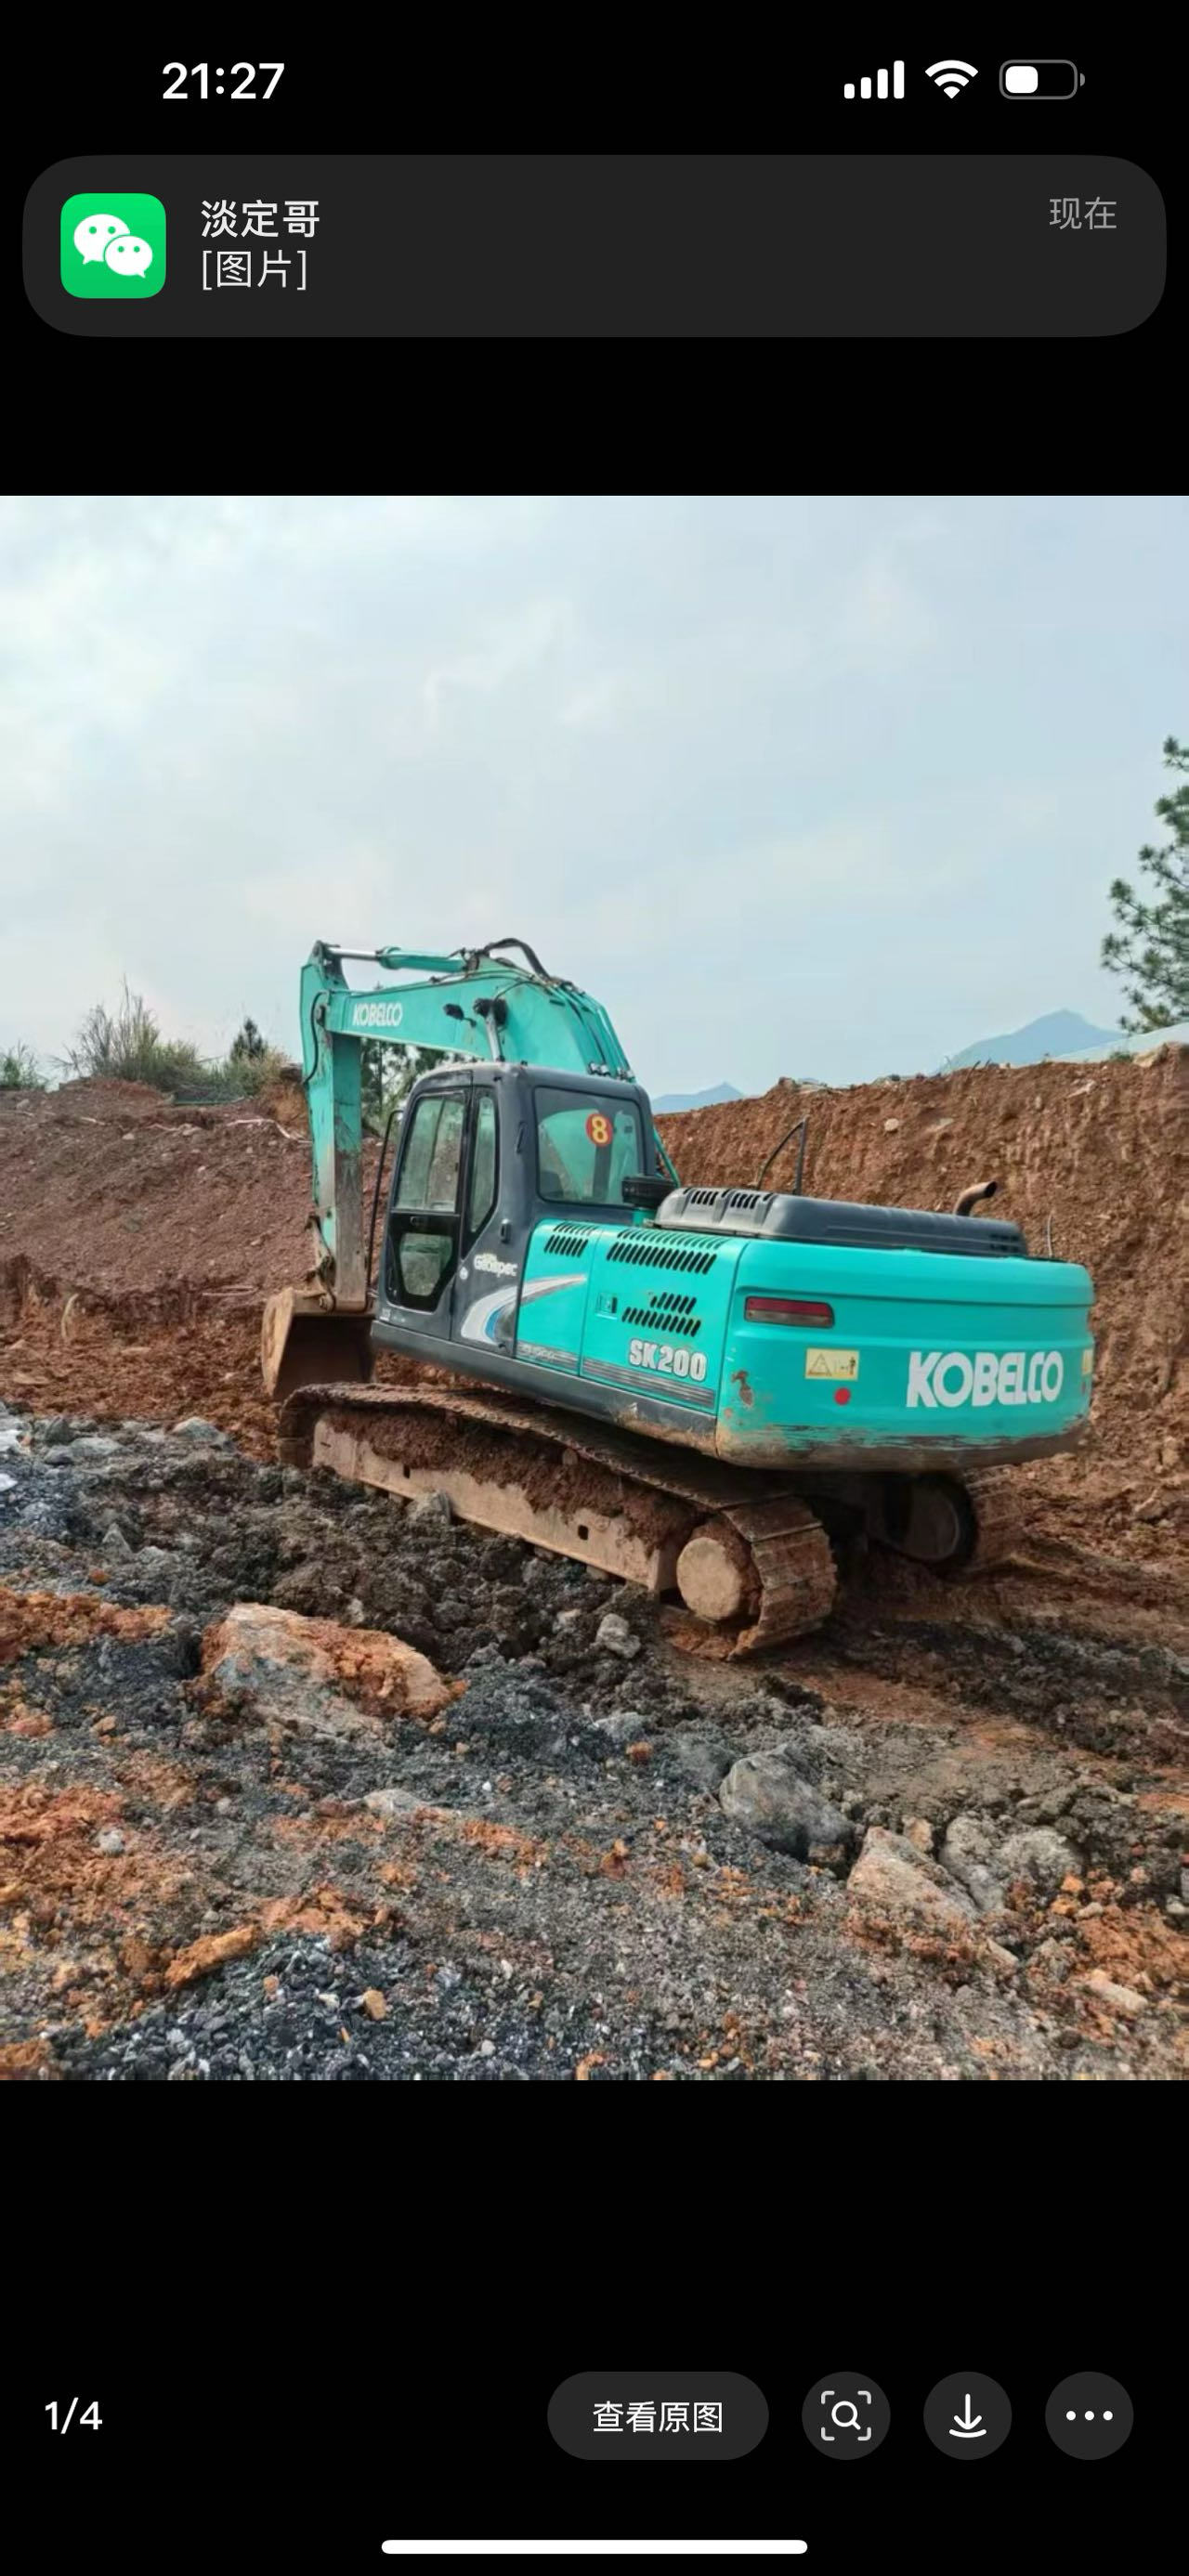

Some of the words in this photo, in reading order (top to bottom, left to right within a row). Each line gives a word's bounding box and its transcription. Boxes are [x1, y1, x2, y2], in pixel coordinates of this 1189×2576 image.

[352, 1002, 403, 1027] KOBELCO
[592, 1116, 608, 1143] 8
[629, 1338, 708, 1382] SK200
[907, 1350, 1065, 1408] KOBELCO
